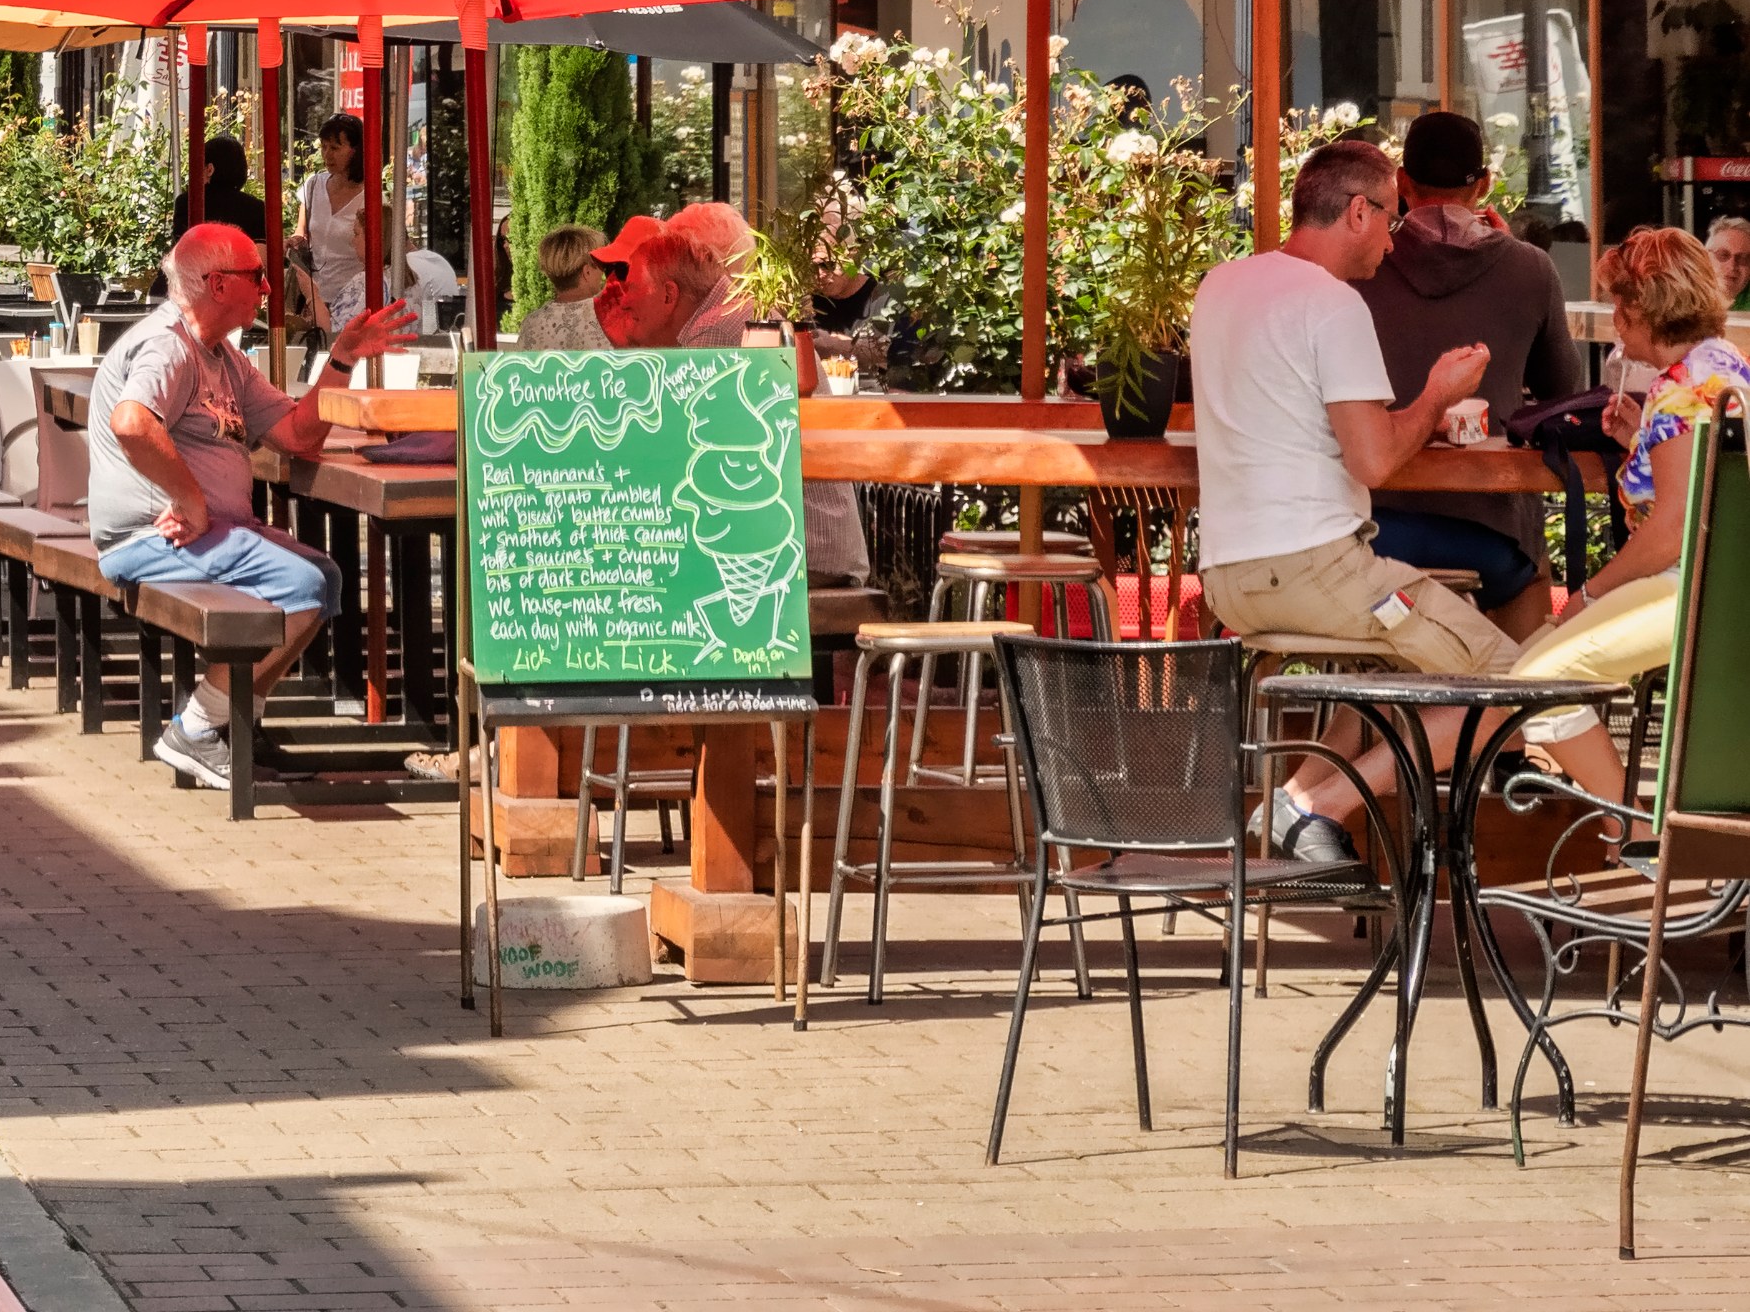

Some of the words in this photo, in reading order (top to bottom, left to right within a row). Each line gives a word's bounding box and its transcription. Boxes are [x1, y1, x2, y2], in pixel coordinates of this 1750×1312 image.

[509, 374, 595, 405] Banoffee
[601, 373, 628, 401] Pie
[483, 462, 515, 487] Real
[477, 493, 538, 515] whippin
[545, 489, 591, 515] gelato
[481, 511, 510, 528] with
[571, 505, 619, 524] butter
[621, 505, 673, 524] crumbs
[496, 529, 562, 548] smothers
[569, 524, 588, 545] of
[592, 524, 630, 544] thick
[634, 522, 688, 544] caramel
[618, 547, 680, 577] crunchy
[519, 571, 534, 588] of
[538, 567, 575, 588] dark
[521, 592, 614, 617] house-make
[618, 589, 663, 614] fresh
[490, 618, 527, 640] each
[531, 615, 560, 650] day
[566, 613, 598, 638] with
[606, 618, 667, 645] organic
[513, 644, 551, 672] Lick
[566, 641, 610, 670] Lick
[522, 960, 579, 978] WOOF
